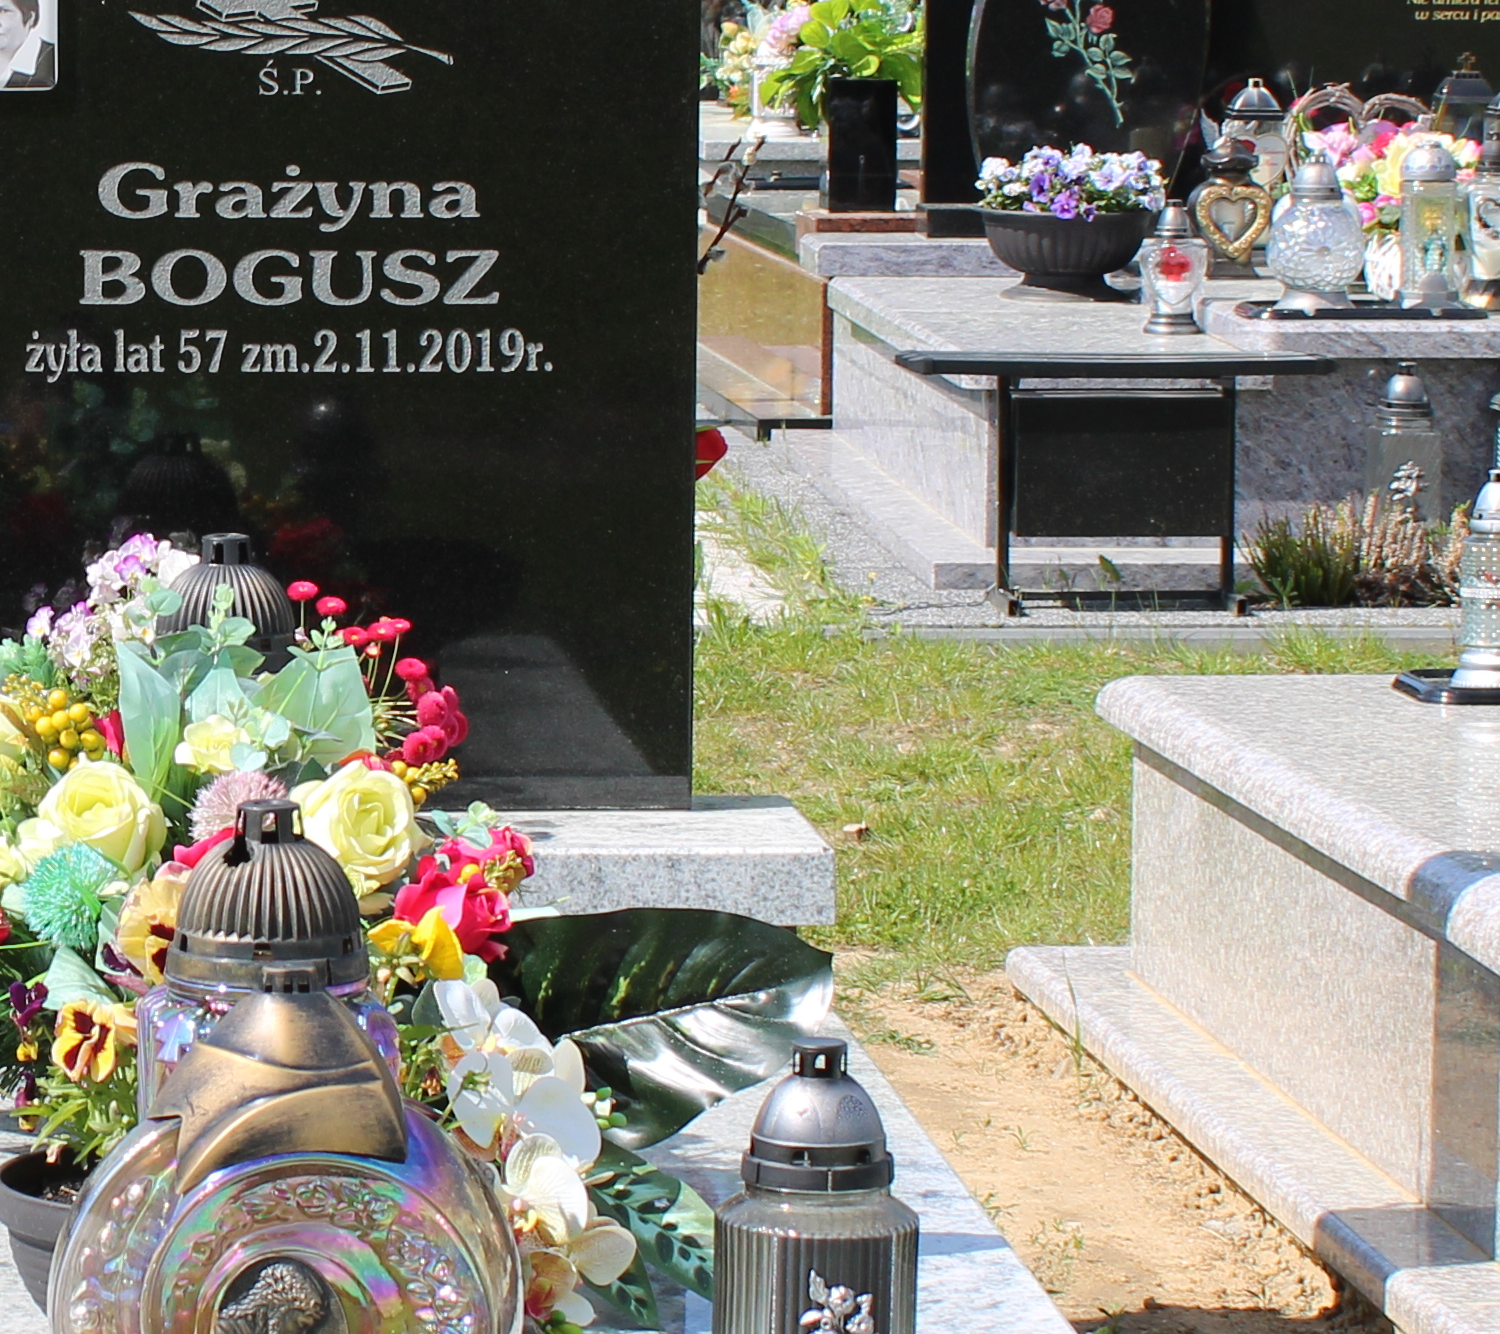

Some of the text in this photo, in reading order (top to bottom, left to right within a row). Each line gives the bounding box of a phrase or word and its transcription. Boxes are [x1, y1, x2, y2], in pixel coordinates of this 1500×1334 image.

[1415, 9, 1430, 20] w
[1432, 9, 1470, 20] sercu
[258, 59, 322, 96] Ś.P.
[98, 161, 481, 233] Grażyna
[79, 248, 500, 306] BOGUSZ
[25, 328, 553, 383] żyła lat 57 zm.2.11.2019r.
